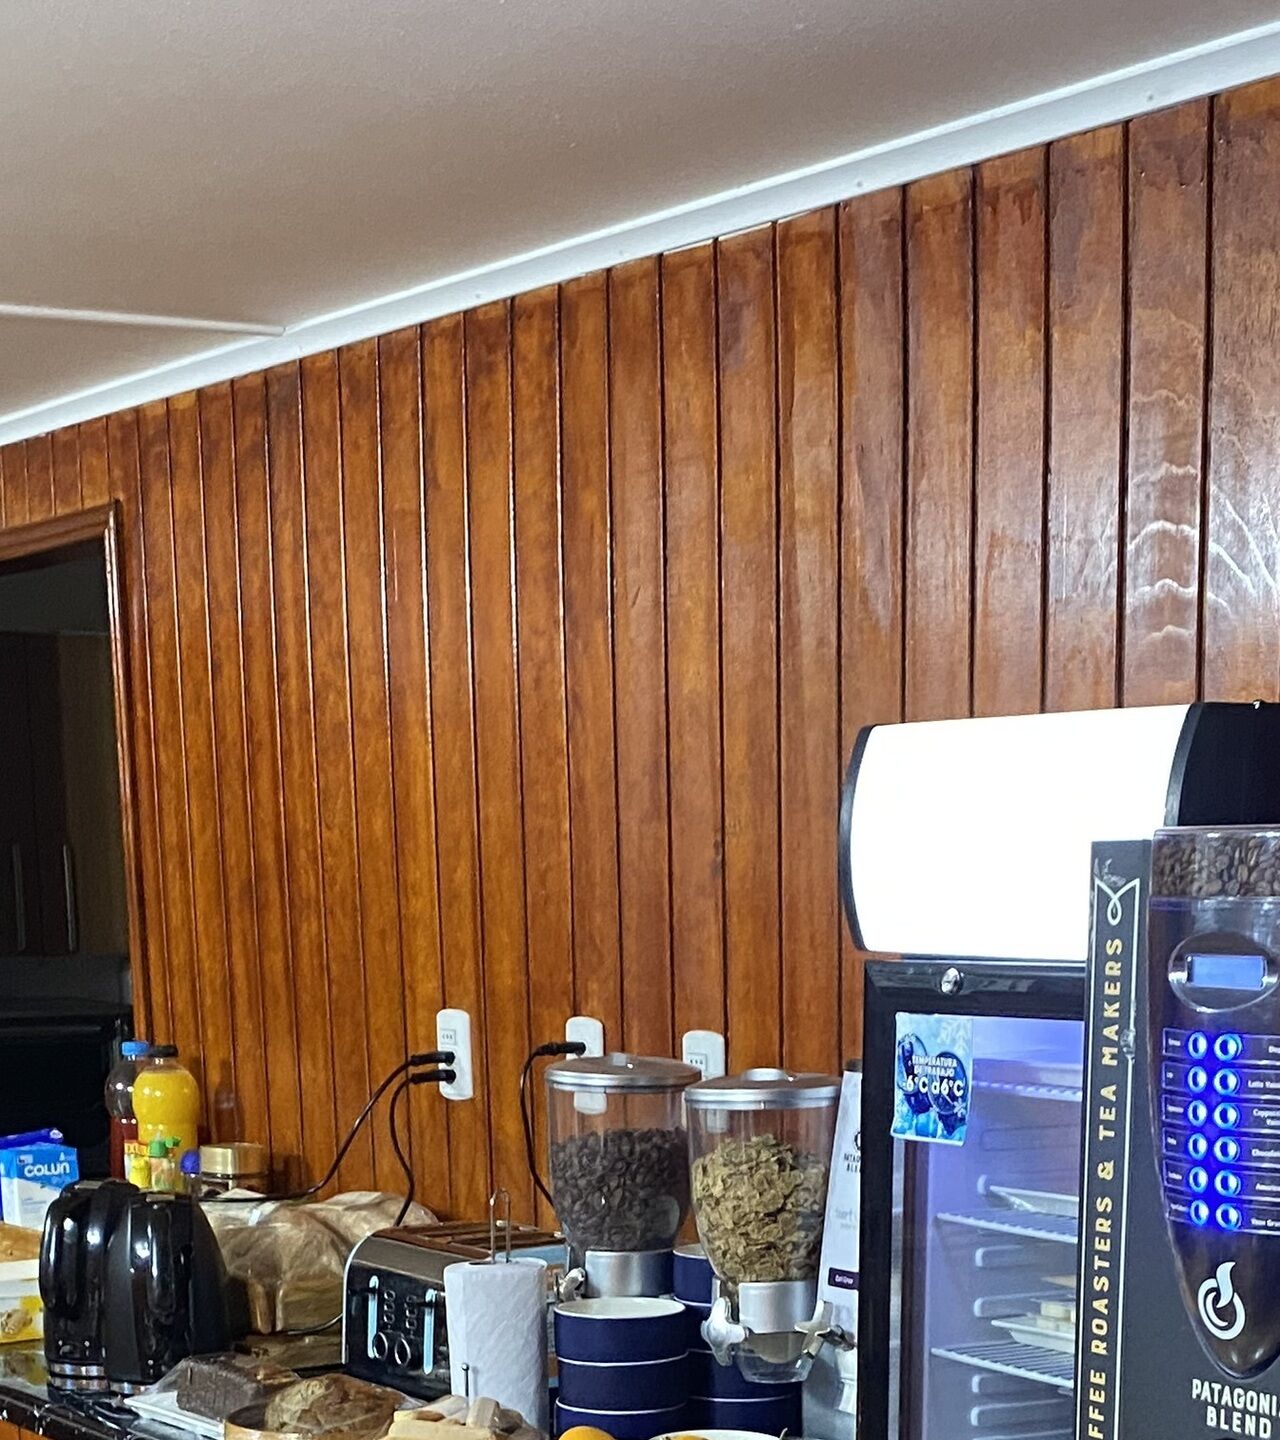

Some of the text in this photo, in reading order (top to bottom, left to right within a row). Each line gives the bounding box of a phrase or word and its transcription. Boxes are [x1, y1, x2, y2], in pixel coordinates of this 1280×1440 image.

[1101, 937, 1124, 1067] MAKERS
[1098, 1083, 1118, 1142] TEA
[1097, 1159, 1115, 1180] &
[1090, 1195, 1113, 1356] ROASTERS
[1206, 1405, 1272, 1439] BLEND
